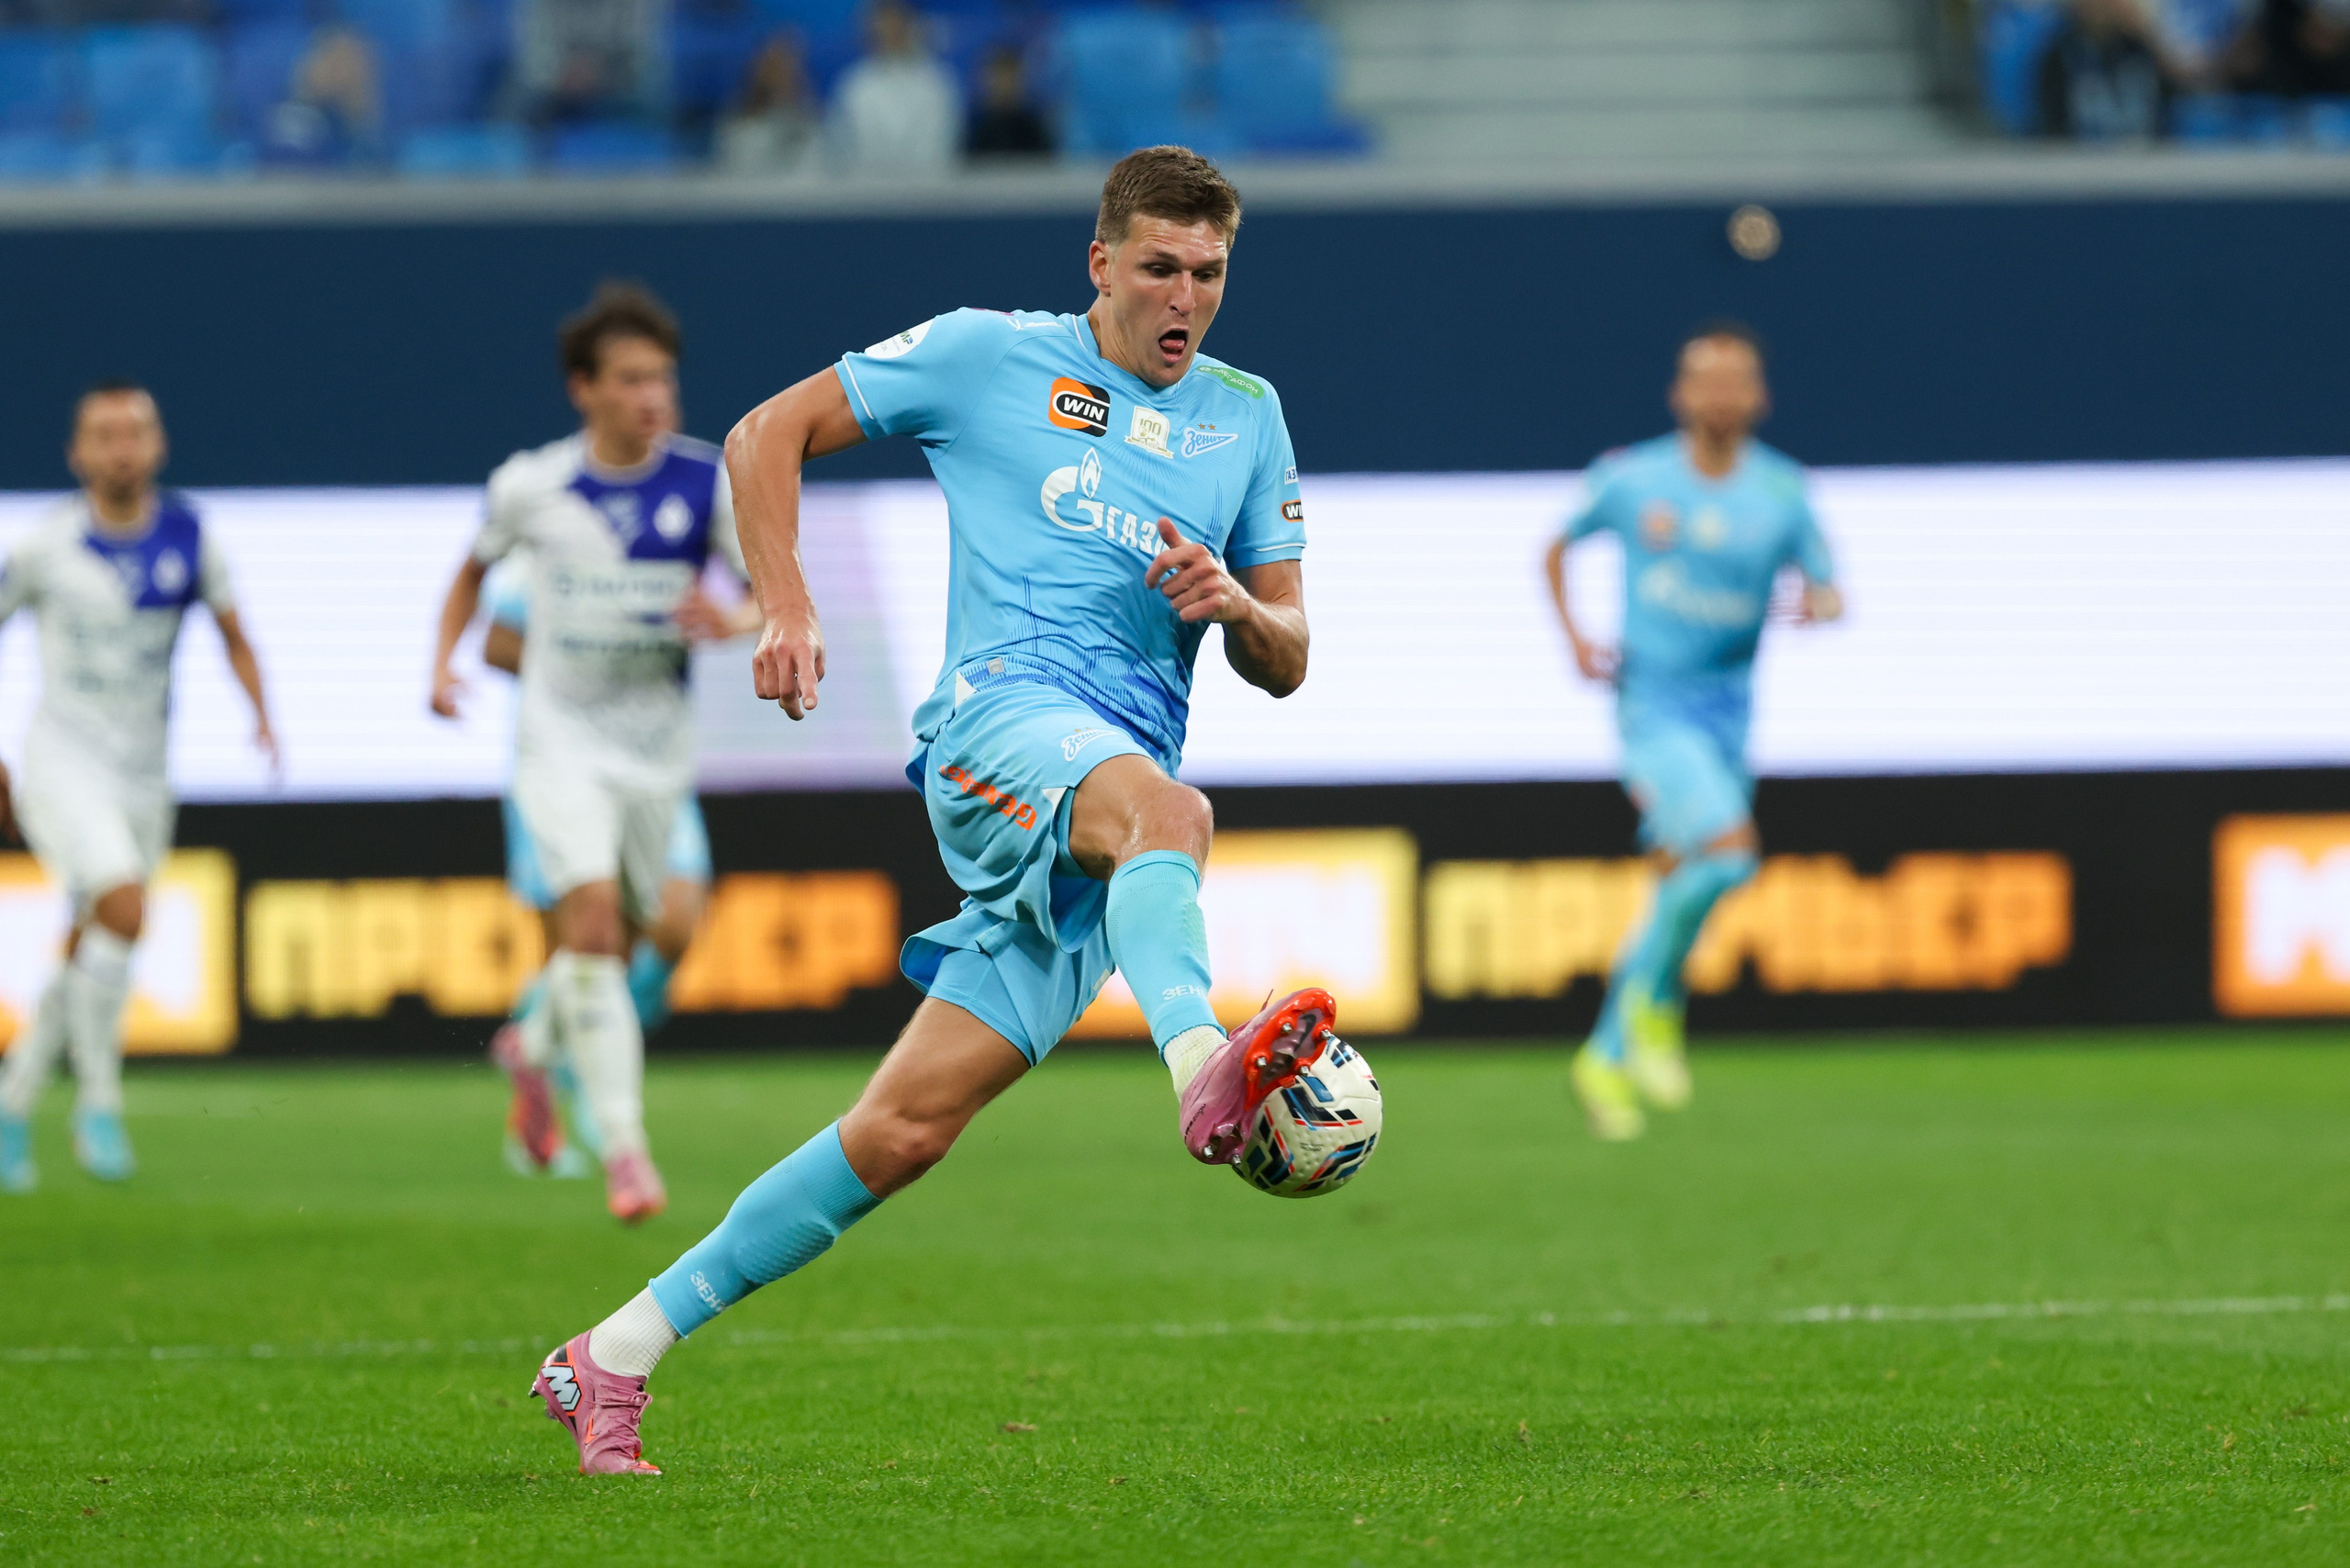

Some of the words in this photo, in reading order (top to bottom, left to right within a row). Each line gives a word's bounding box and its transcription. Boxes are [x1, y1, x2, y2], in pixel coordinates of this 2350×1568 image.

[1213, 368, 1259, 394] МЕГАФОН
[1063, 397, 1105, 421] WIN
[1161, 984, 1207, 1001] ЗЕН
